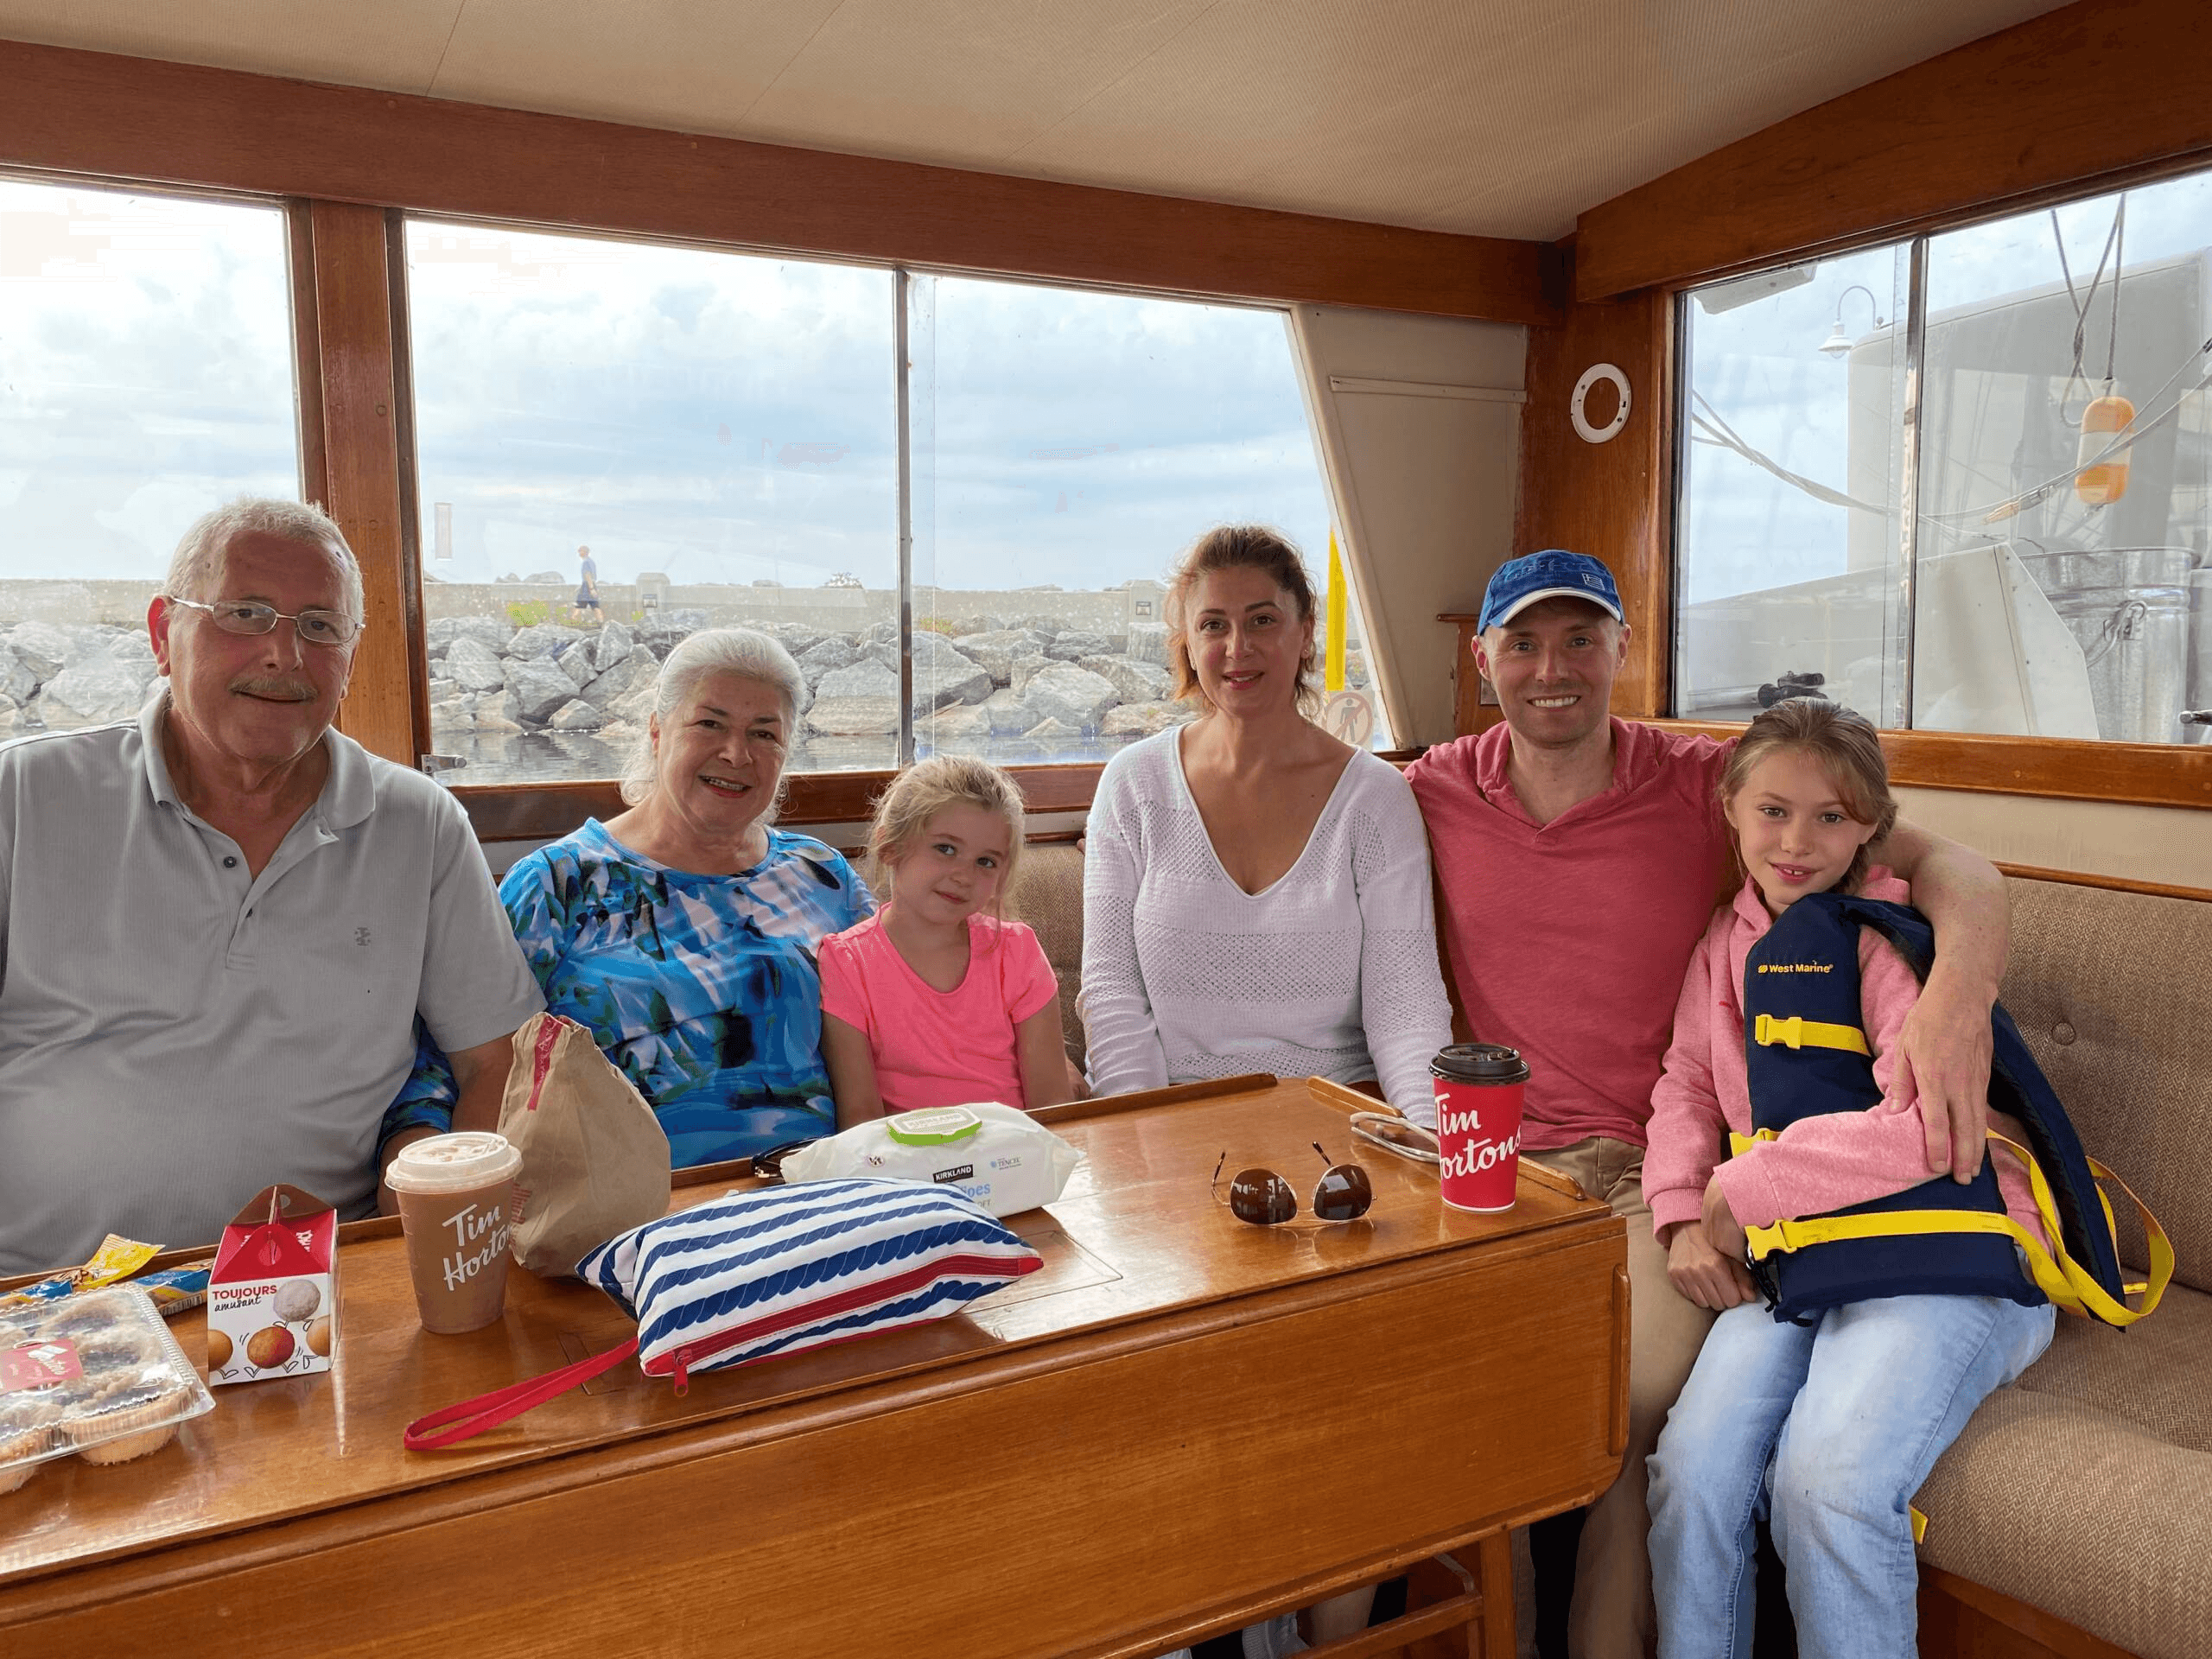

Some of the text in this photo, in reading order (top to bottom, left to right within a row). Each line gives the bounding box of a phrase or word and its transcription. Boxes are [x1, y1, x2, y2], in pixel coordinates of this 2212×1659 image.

[1769, 964, 1795, 974] West
[1434, 1092, 1481, 1136] Tim
[1440, 1124, 1521, 1180] ortons
[935, 1166, 972, 1181] KIRKLAND
[442, 1204, 500, 1247] Tim
[212, 1284, 277, 1300] TOUJOURS
[214, 1294, 262, 1312] amusant
